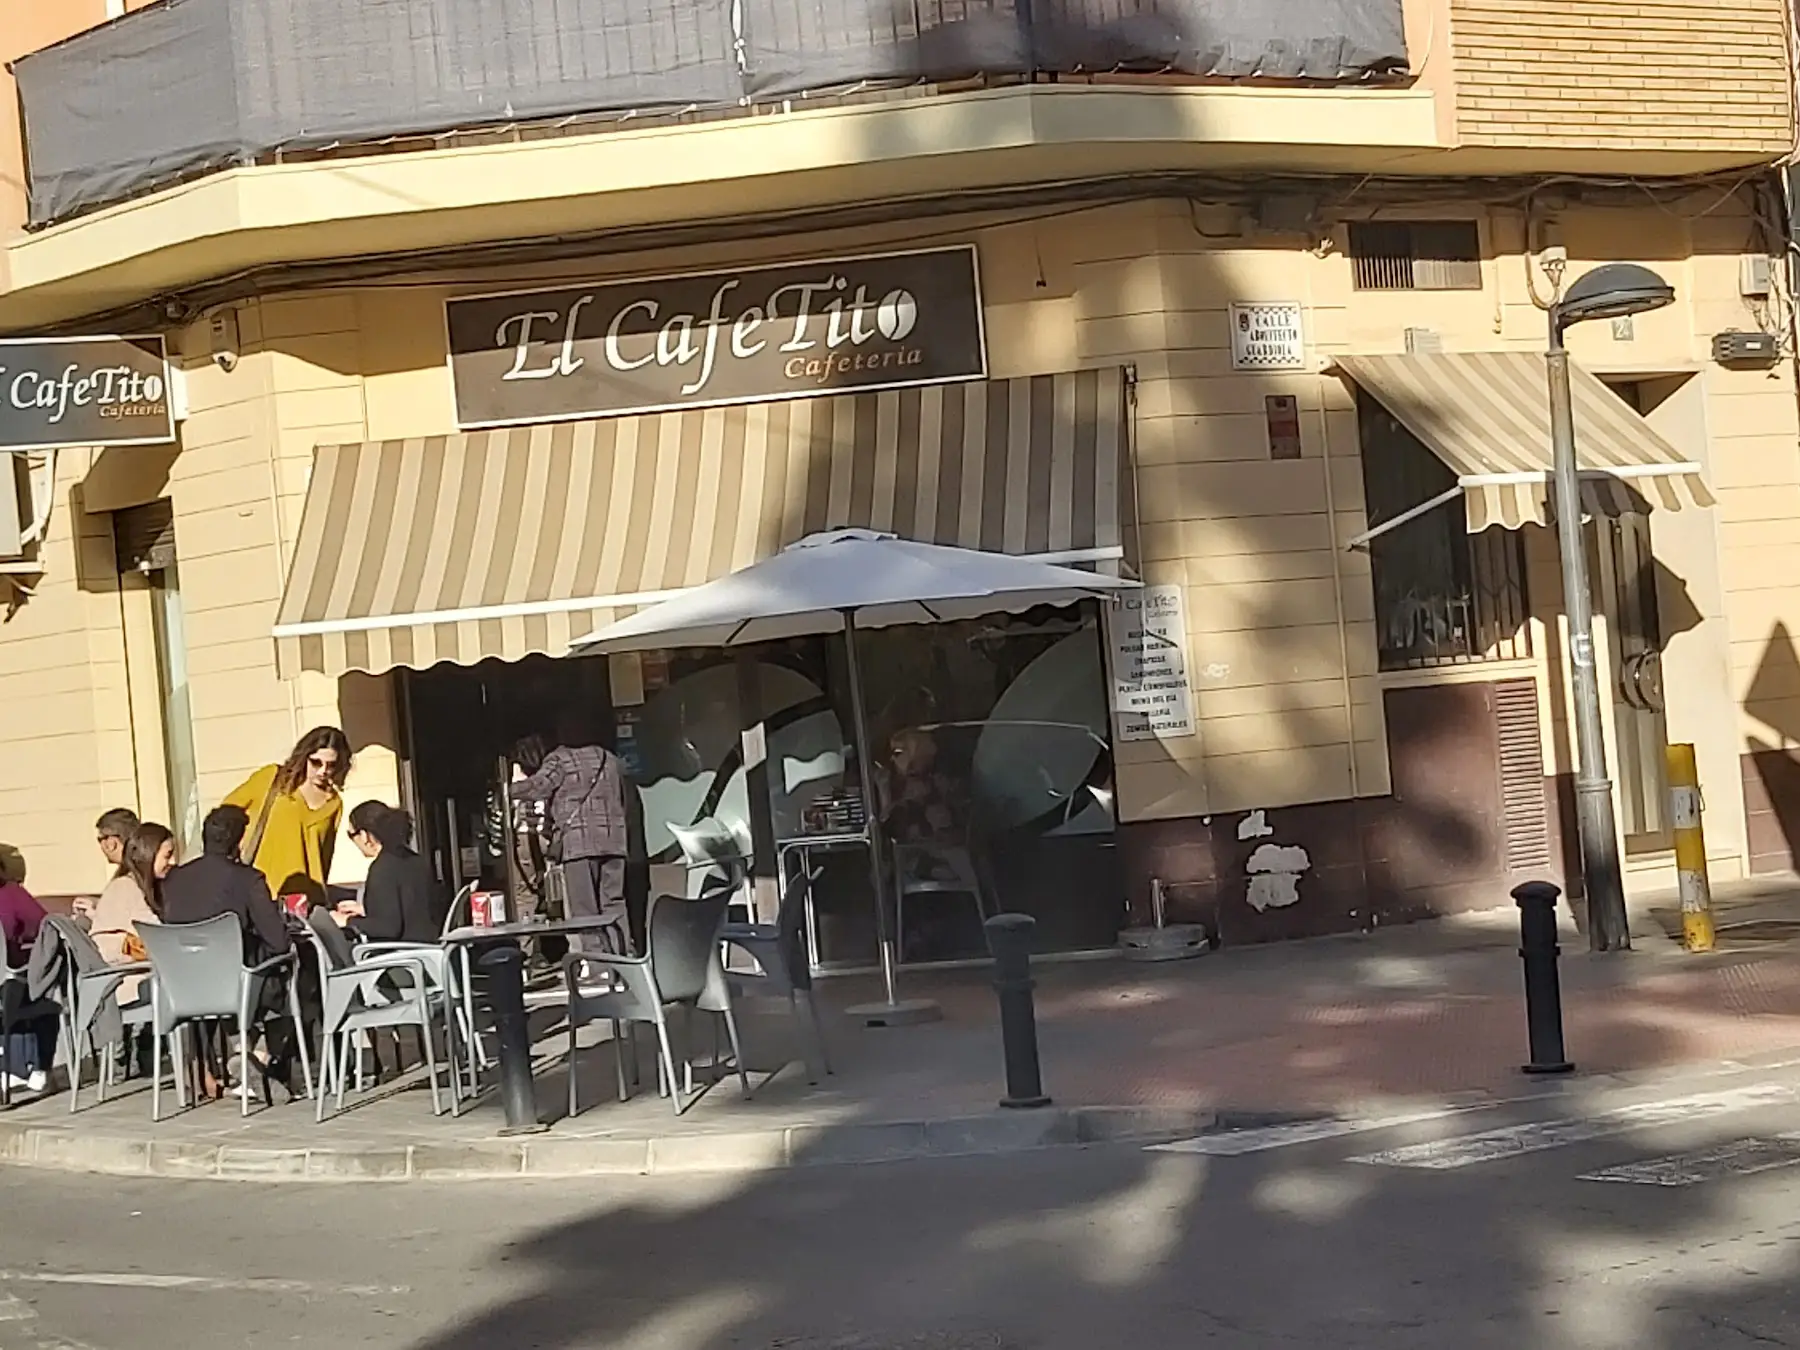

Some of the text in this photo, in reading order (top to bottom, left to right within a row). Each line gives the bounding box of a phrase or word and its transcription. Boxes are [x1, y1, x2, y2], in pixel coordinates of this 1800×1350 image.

[1255, 314, 1292, 327] CALLE
[496, 273, 919, 396] El CafeTito
[1250, 329, 1297, 342] ARQUITECTO
[784, 345, 923, 384] Cafeteria
[10, 364, 163, 424] CafeTito
[100, 404, 165, 420] Cafeteria
